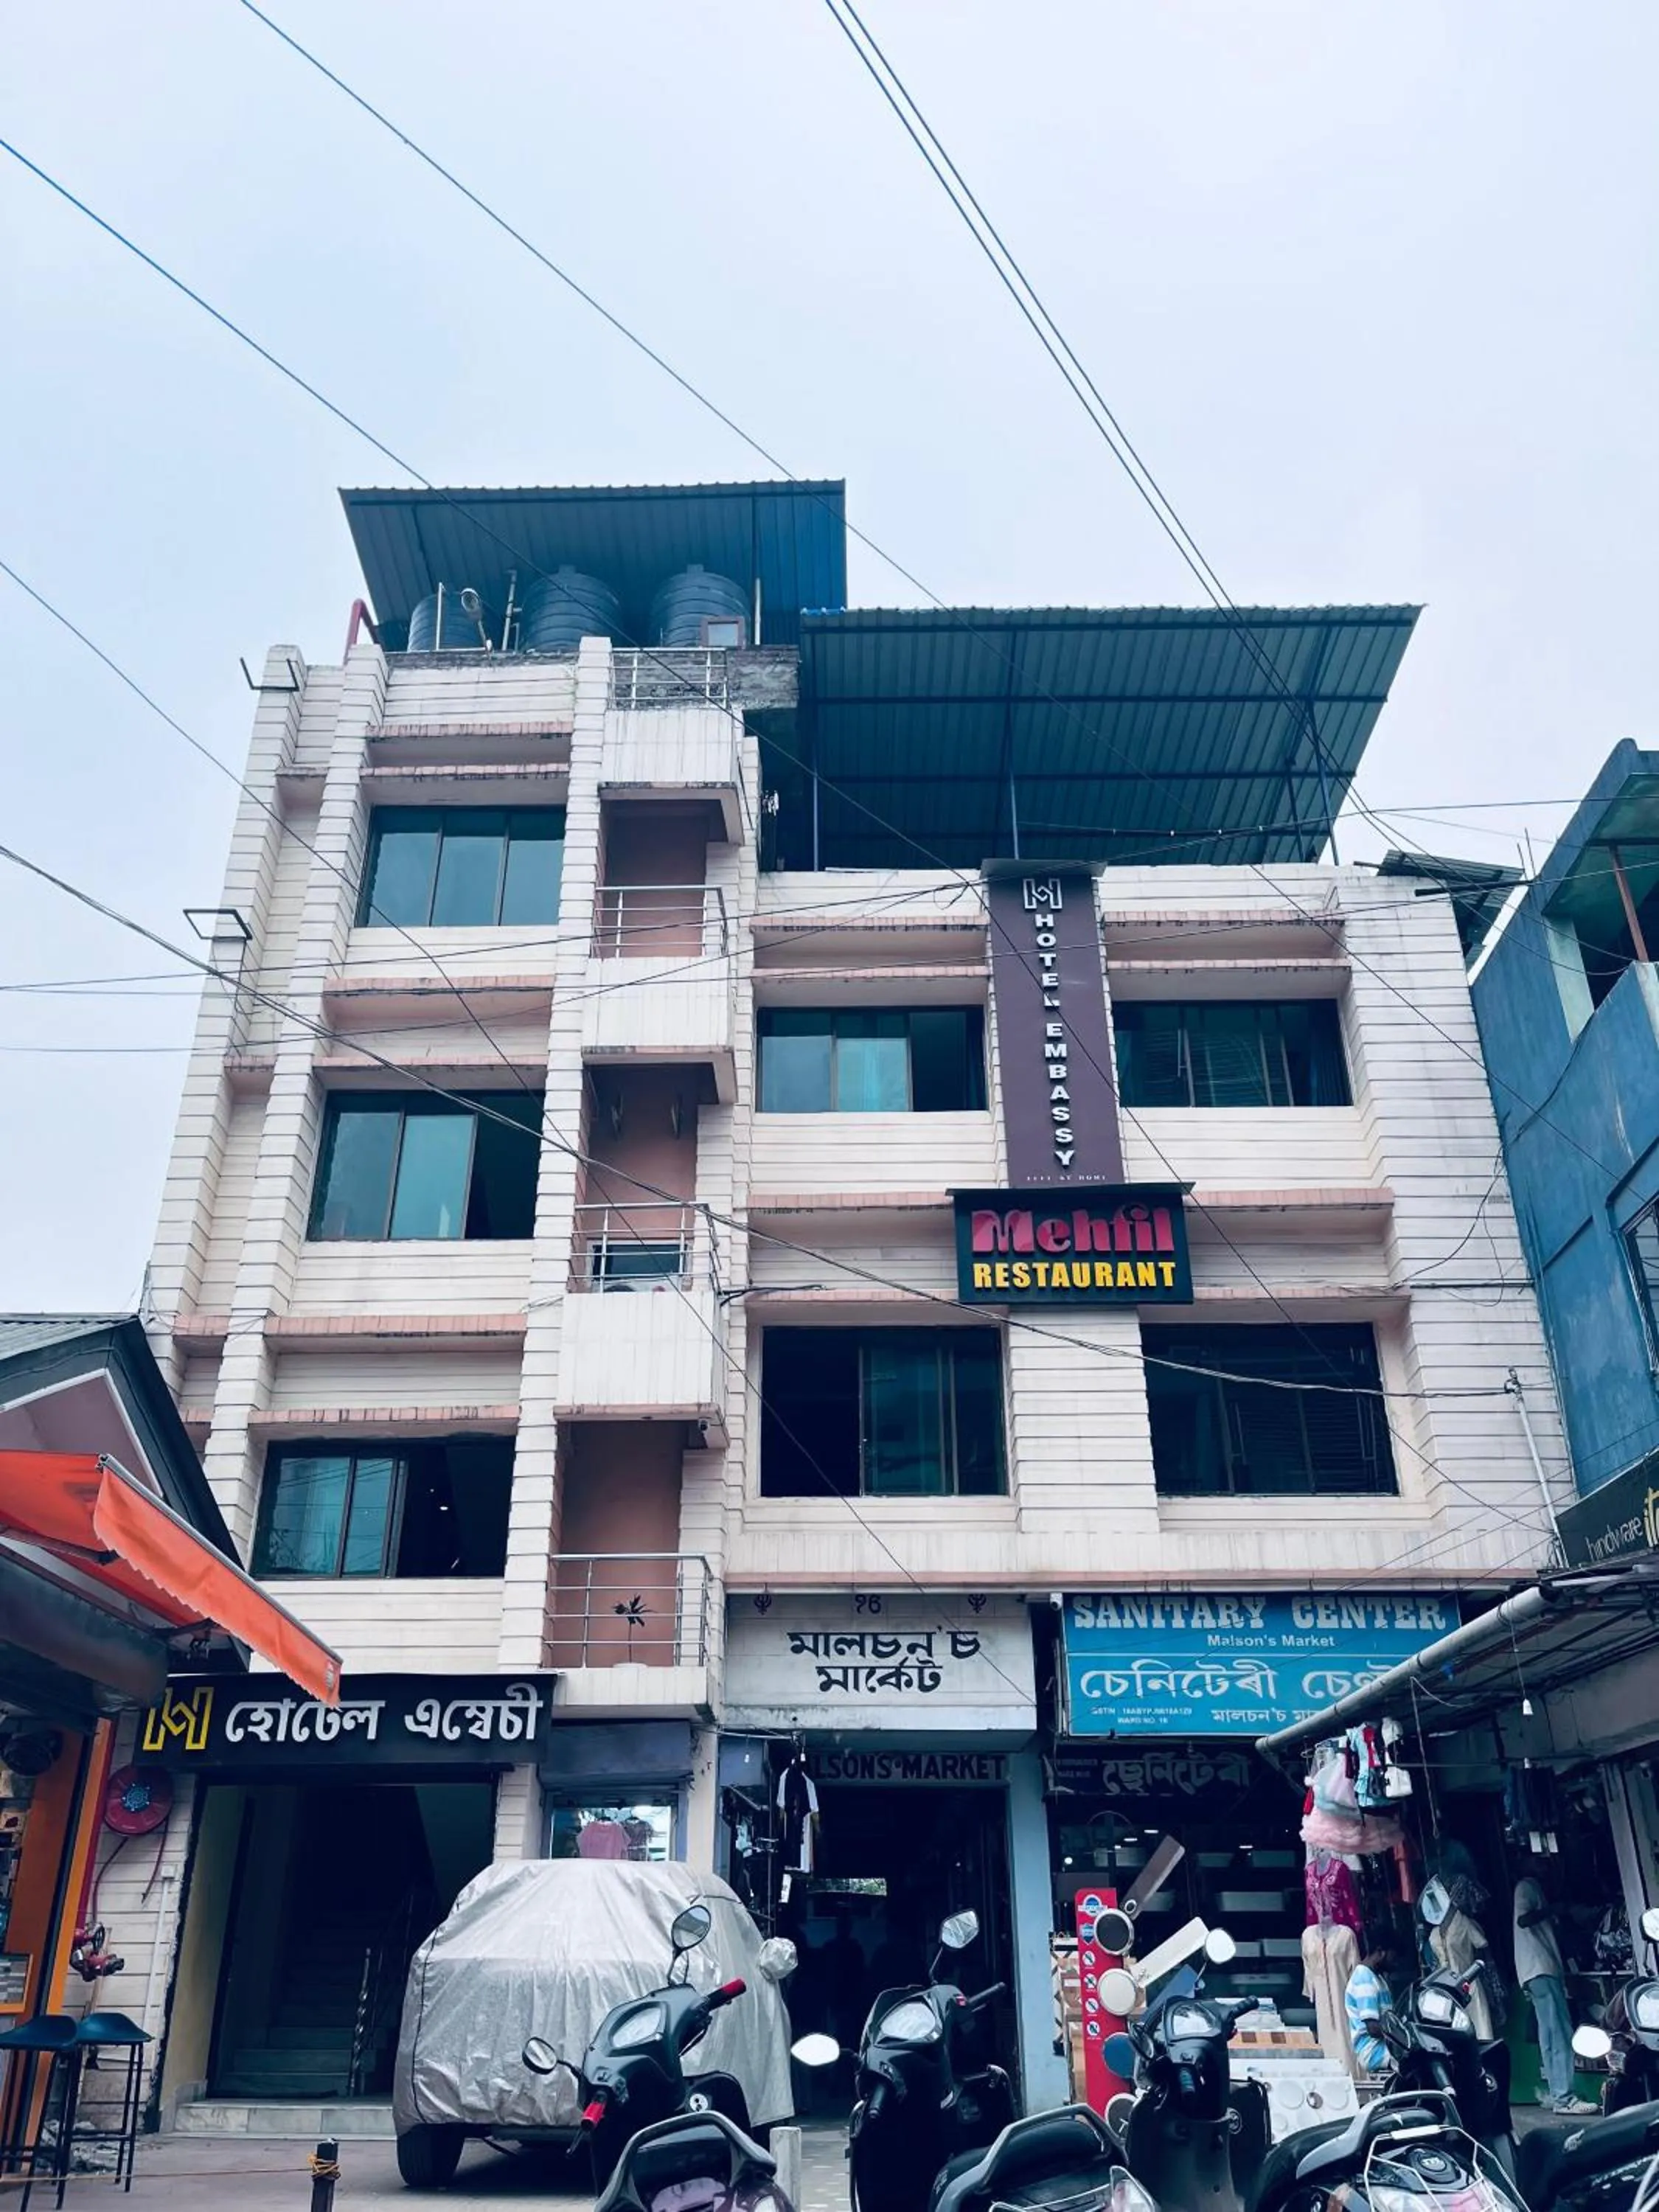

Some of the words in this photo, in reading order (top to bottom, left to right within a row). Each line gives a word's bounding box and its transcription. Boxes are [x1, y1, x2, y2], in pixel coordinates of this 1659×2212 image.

[1034, 914, 1060, 1007] HOTEL
[1044, 1023, 1075, 1167] EMBASSY
[971, 1203, 1175, 1253] Mehfil
[973, 1262, 1175, 1288] RESTAURANT
[1074, 1596, 1266, 1629] SANITARY
[1291, 1595, 1446, 1630] CENTER
[1281, 1634, 1335, 1647] Market
[902, 1754, 1006, 1781] MARKET
